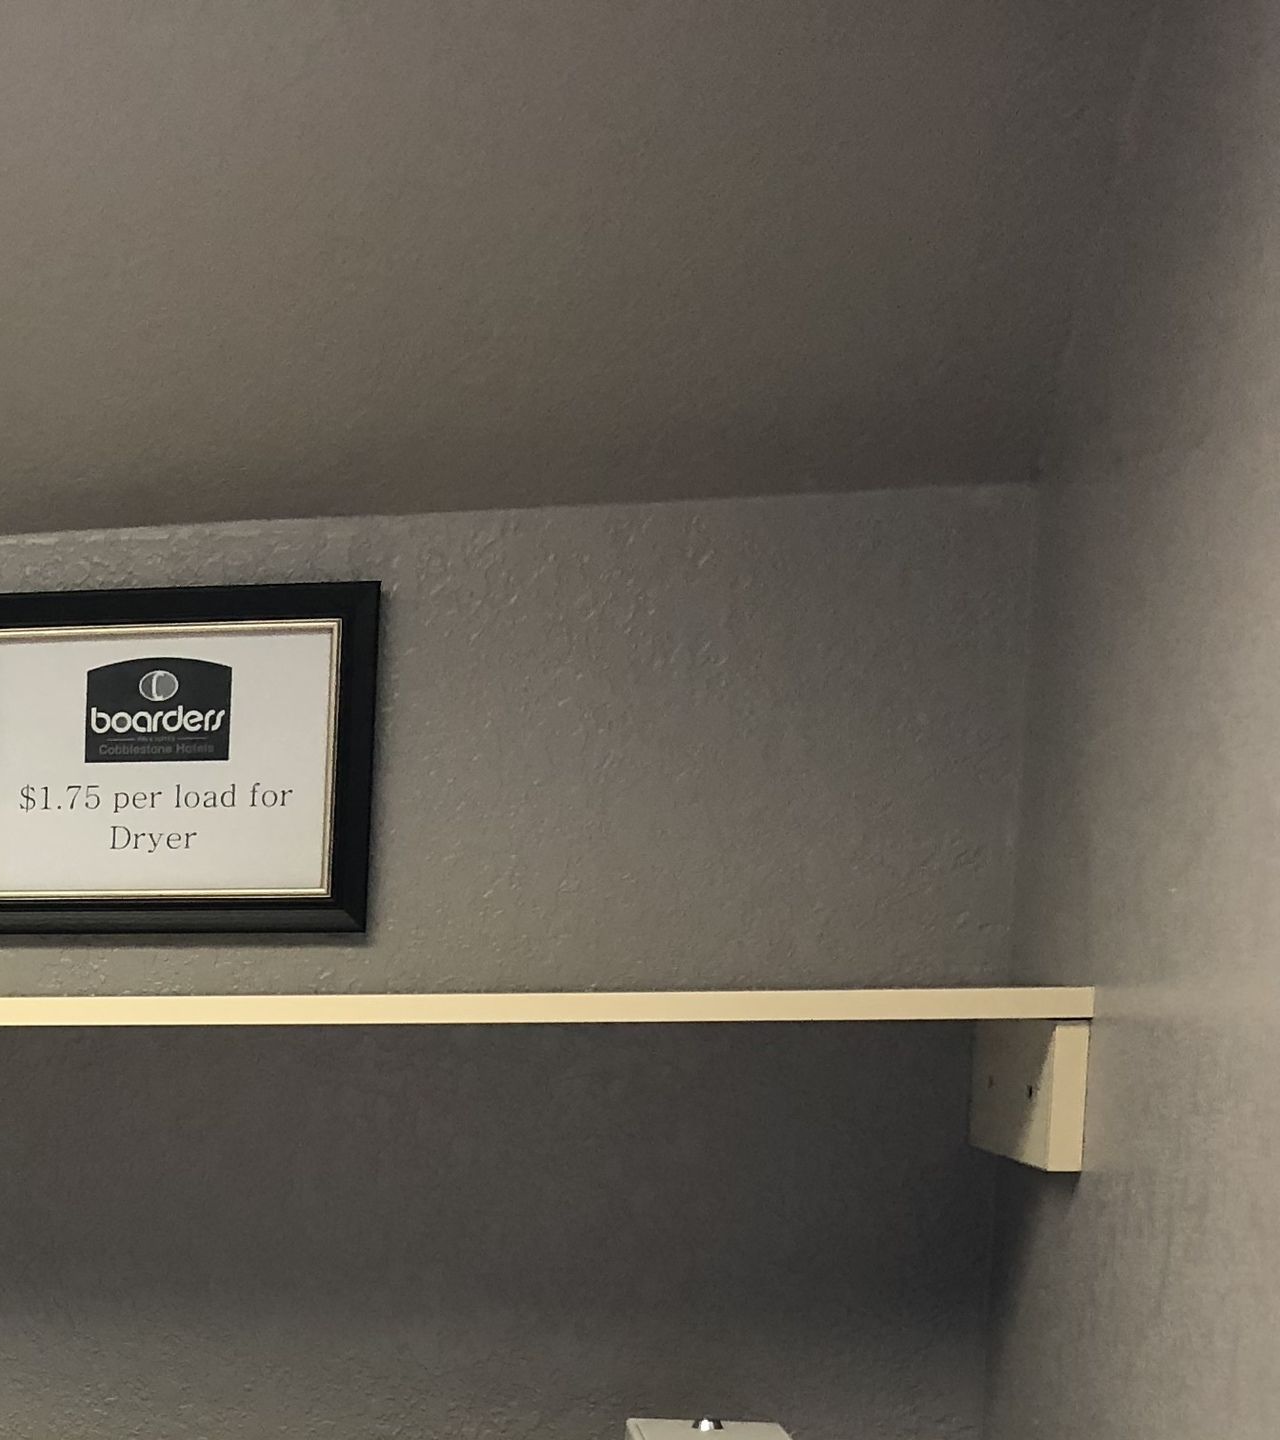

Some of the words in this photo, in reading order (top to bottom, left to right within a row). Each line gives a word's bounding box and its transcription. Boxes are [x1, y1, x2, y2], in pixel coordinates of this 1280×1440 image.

[90, 704, 226, 734] boarders
[19, 784, 101, 813] $1.75
[113, 790, 163, 813] per
[174, 783, 237, 809] load
[249, 782, 294, 808] for
[109, 825, 198, 854] Dryer
